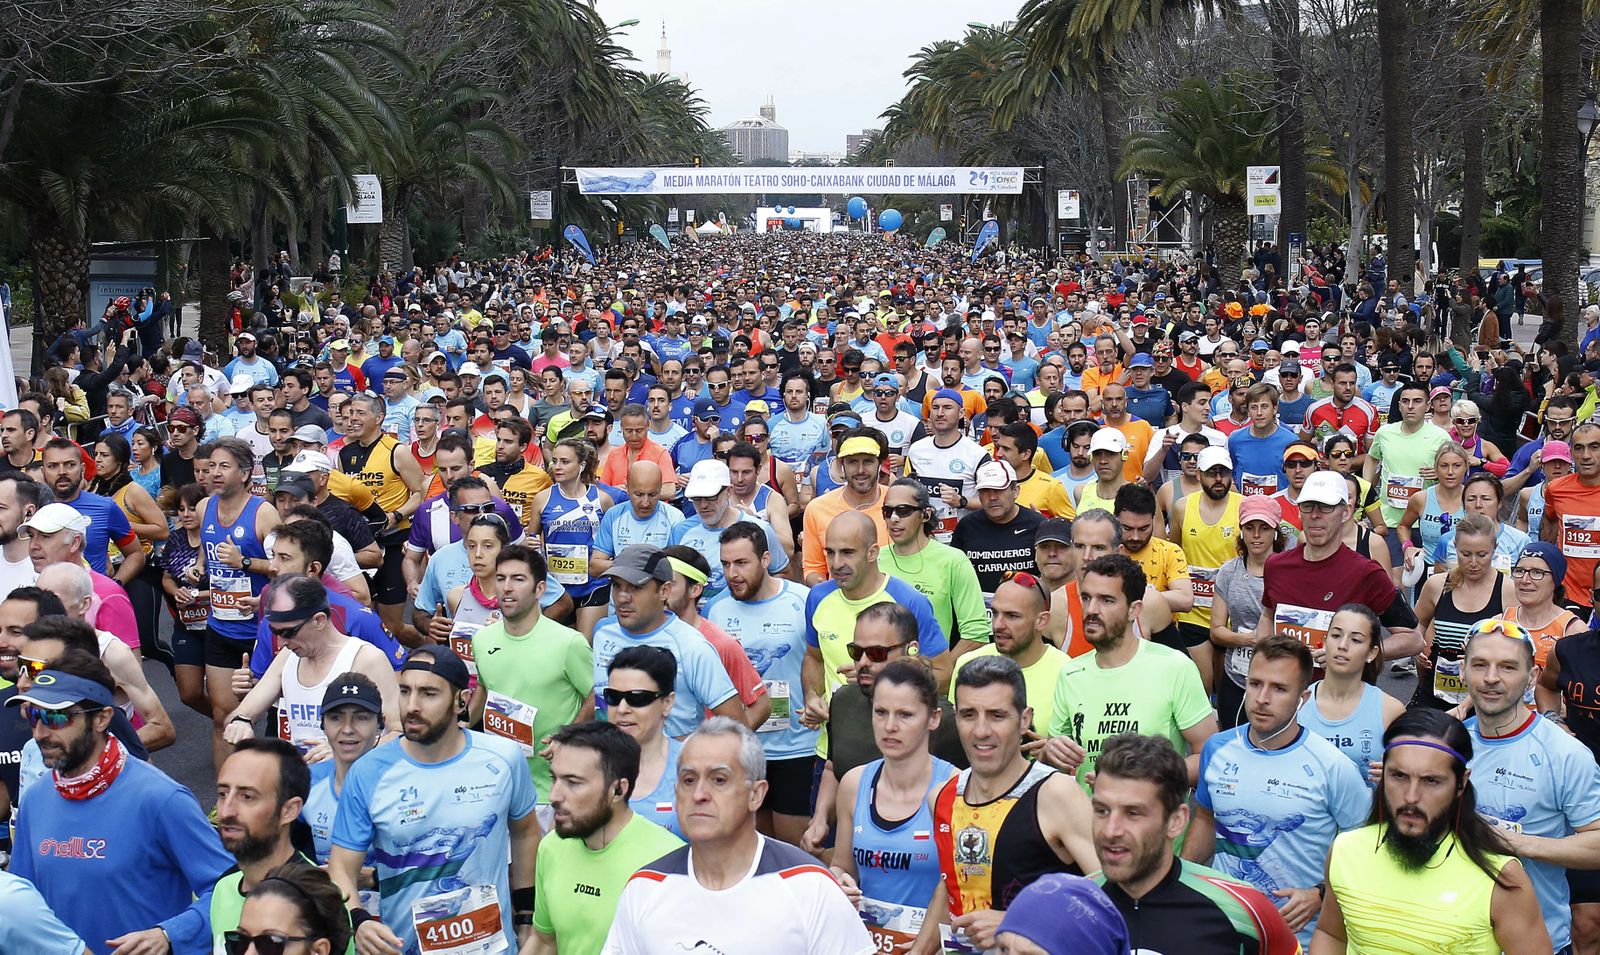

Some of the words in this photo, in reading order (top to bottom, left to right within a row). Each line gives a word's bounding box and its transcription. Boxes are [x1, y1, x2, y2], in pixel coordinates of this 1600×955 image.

[663, 175, 693, 188] MEDIA
[695, 173, 741, 187] MARATÓN
[744, 175, 779, 187] TEATRO
[781, 175, 864, 187] SOHO-CAIXABANK
[866, 175, 901, 187] CIUDAD
[903, 175, 915, 187] DE
[917, 172, 956, 187] MÁLAGA
[969, 170, 989, 186] 24
[1388, 486, 1409, 497] 4033
[1567, 531, 1592, 543] 3192
[966, 547, 1031, 560] DOMINGUEROS
[552, 559, 575, 569] 7925
[977, 560, 1034, 573] CARRANQUE
[212, 592, 235, 605] 5013
[184, 607, 207, 619] 4940
[457, 641, 473, 656] 51
[1440, 677, 1468, 688] 701
[1104, 703, 1131, 717] XXX
[488, 714, 515, 734] 3611
[1097, 720, 1139, 735] MEDIA
[1223, 762, 1239, 776] 24
[399, 786, 418, 802] 24
[880, 852, 912, 871] RUN
[914, 853, 929, 861] TEAM
[912, 909, 925, 920] 24
[426, 918, 474, 942] 4100
